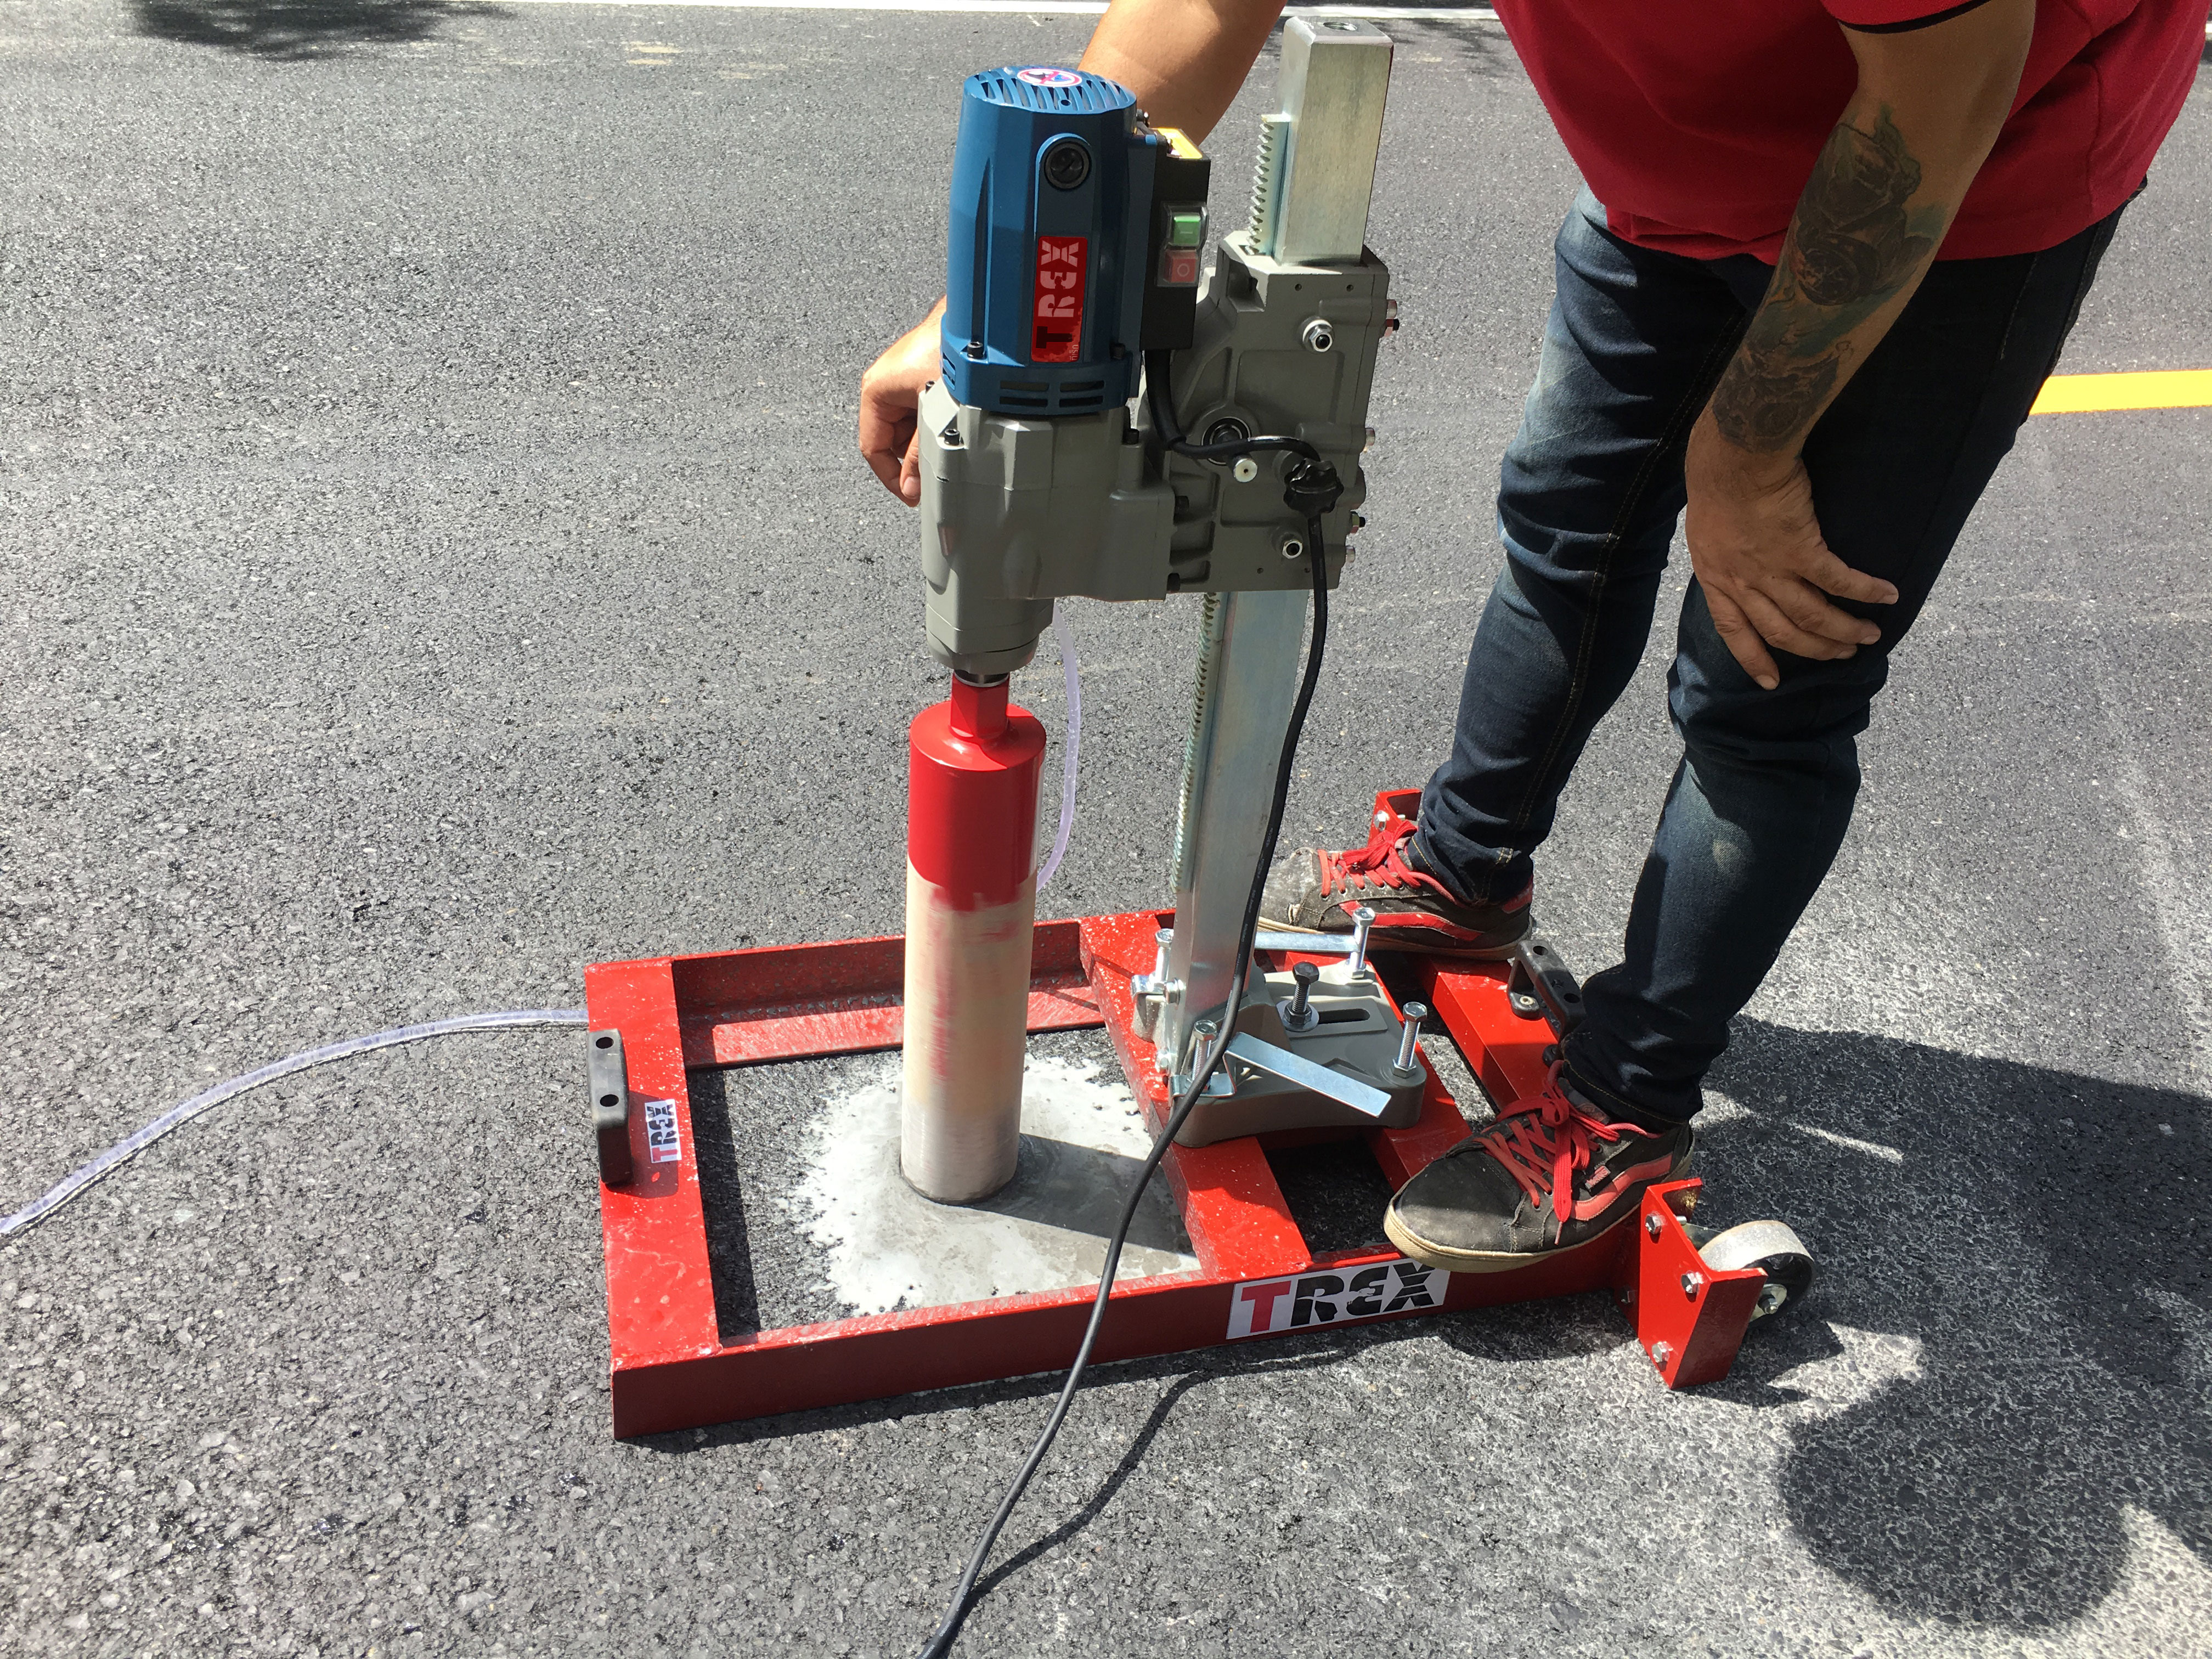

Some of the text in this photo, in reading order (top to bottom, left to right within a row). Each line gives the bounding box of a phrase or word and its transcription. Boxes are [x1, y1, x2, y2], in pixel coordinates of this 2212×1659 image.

[1036, 240, 1079, 348] TREX
[646, 1103, 678, 1162] TREX
[1241, 1262, 1435, 1334] TREX
